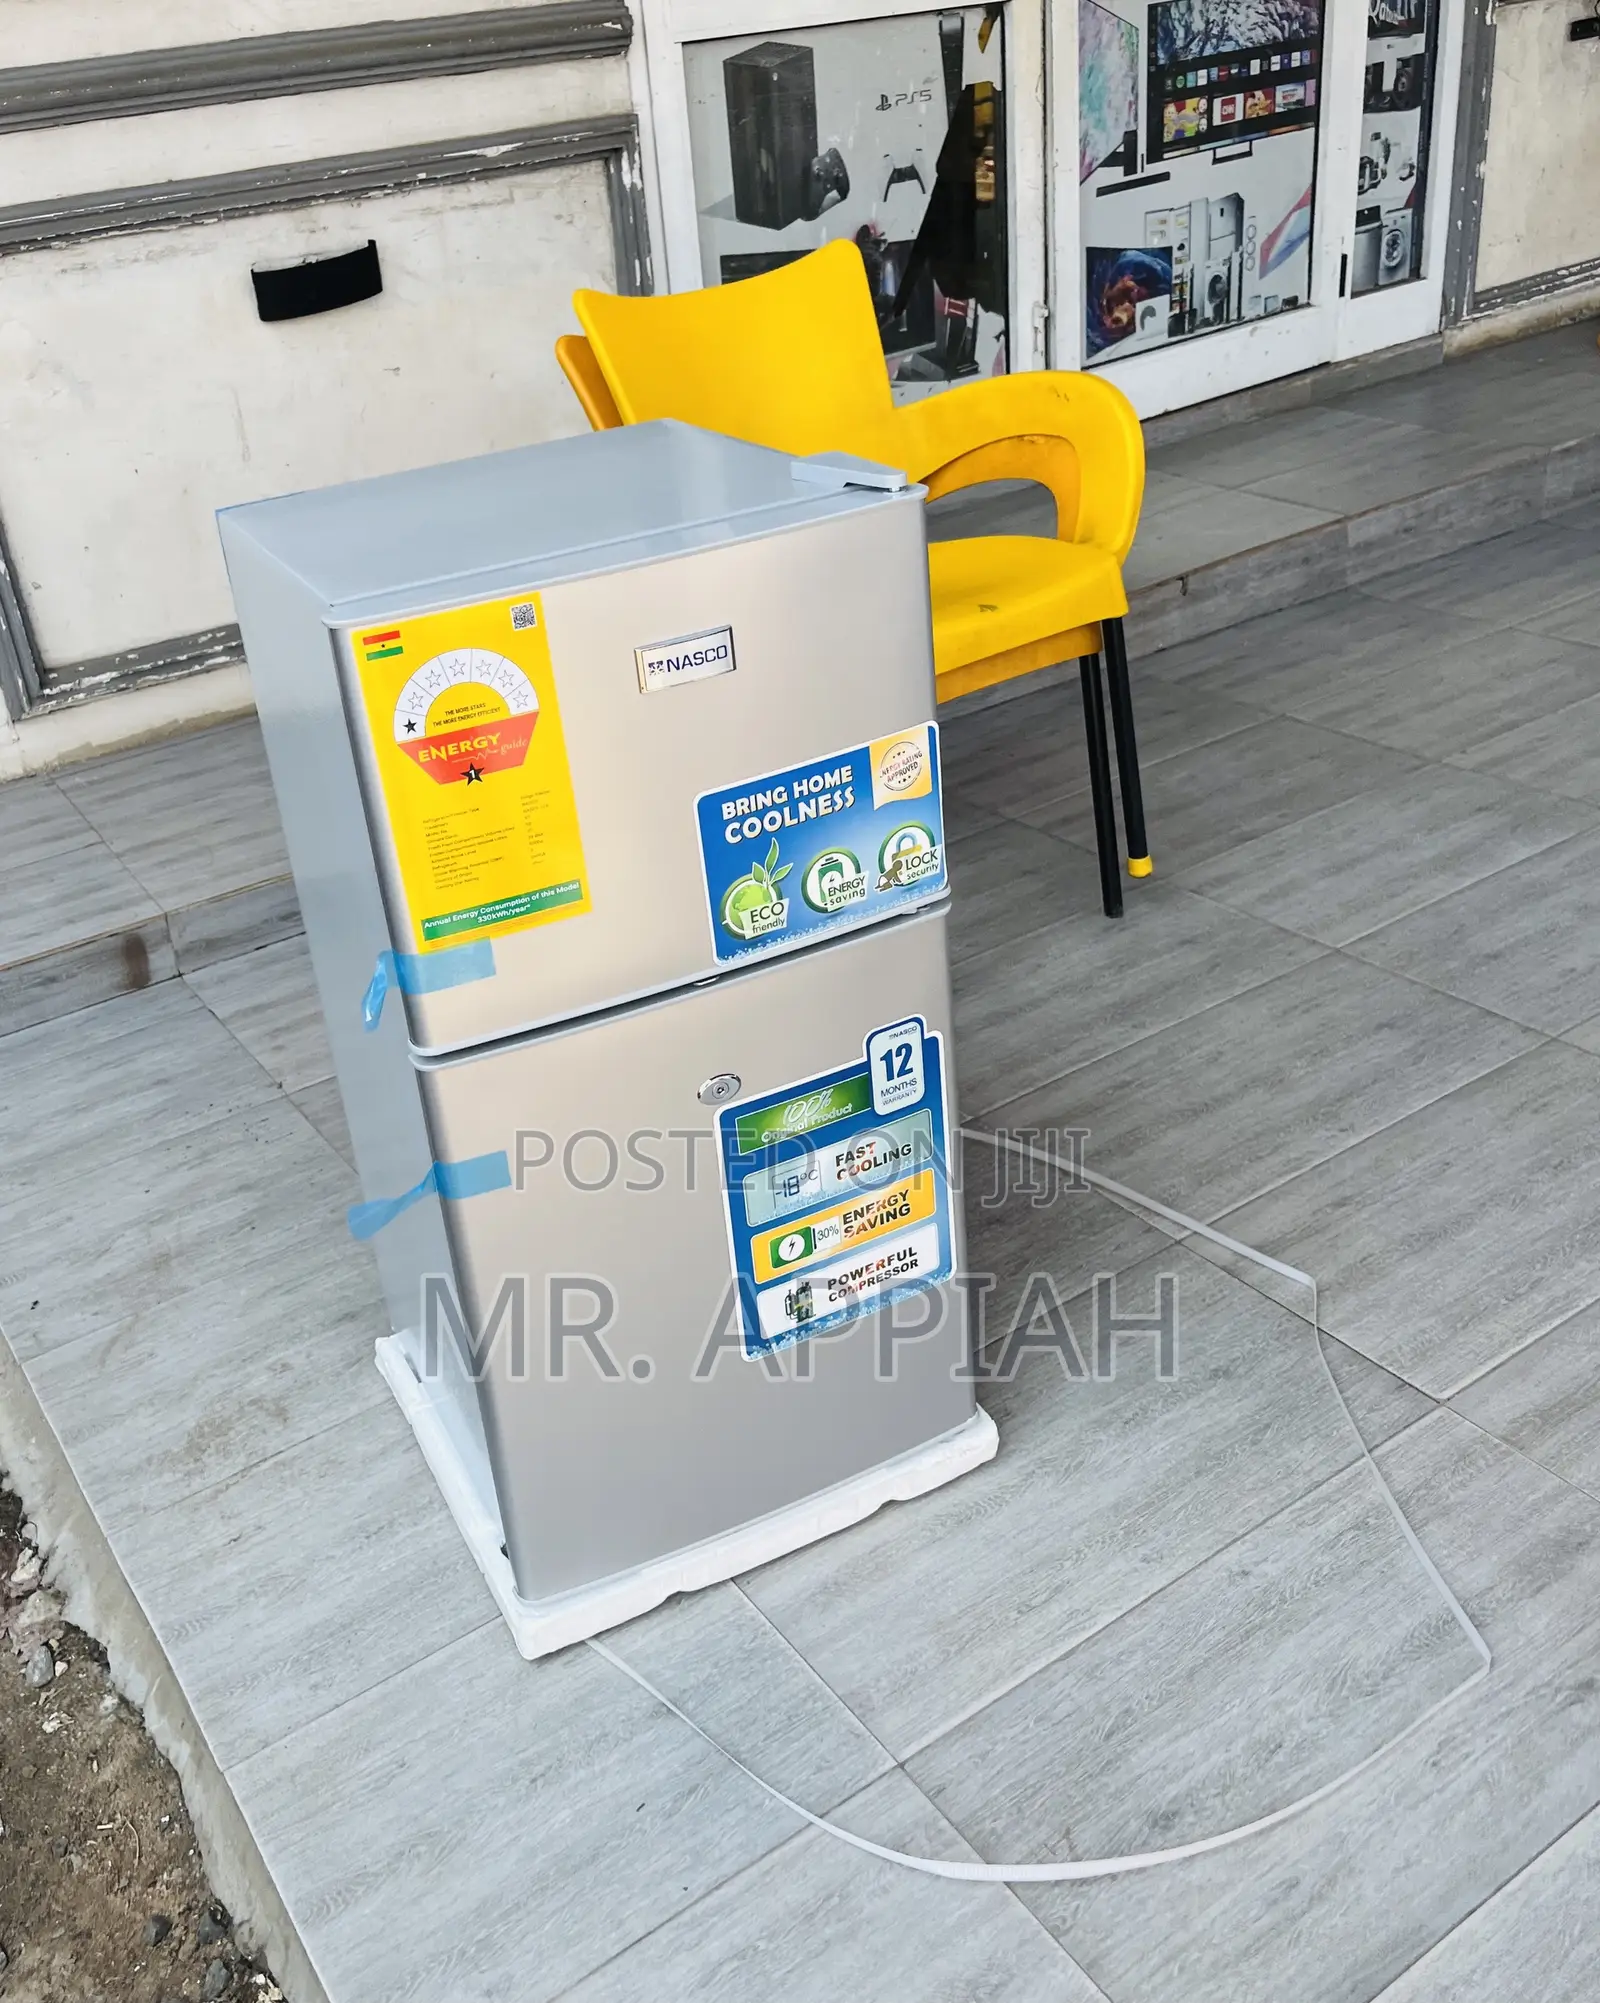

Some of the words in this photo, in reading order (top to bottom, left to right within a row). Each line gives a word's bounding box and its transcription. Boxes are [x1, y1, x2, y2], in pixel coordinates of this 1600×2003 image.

[895, 89, 932, 106] PS5
[666, 644, 728, 673] NASCO
[445, 708, 455, 717] THE
[455, 706, 469, 715] MORE
[470, 702, 487, 712] STARS
[432, 720, 442, 729] THE
[443, 717, 457, 725] MORE
[457, 713, 477, 723] ENERGY
[418, 732, 501, 764] ENERGY
[500, 737, 529, 756] guide
[469, 769, 476, 779] 1
[887, 761, 919, 783] APPROVED
[721, 786, 789, 821] BRING
[792, 765, 854, 799] HOME
[724, 785, 856, 844] COOLNESS
[905, 848, 939, 871] LOCK
[906, 863, 940, 881] security
[828, 875, 866, 897] ENERGY
[424, 916, 452, 929] Annual
[452, 910, 479, 923] Energy
[479, 897, 531, 914] Consumption
[531, 892, 540, 901] of
[540, 889, 555, 899] this
[556, 881, 580, 895] Model
[829, 888, 866, 907] saving
[750, 903, 785, 924] ECO
[752, 918, 786, 935] friendly
[893, 1025, 918, 1039] NASCO
[880, 1042, 914, 1083] 12
[880, 1077, 918, 1098] MONTHS
[882, 1088, 917, 1106] WARRANTY
[783, 1088, 834, 1126] 100%
[761, 1117, 808, 1143] Original
[811, 1102, 853, 1126] Product
[835, 1141, 877, 1167] FAST
[836, 1143, 912, 1181] COOLING
[842, 1189, 909, 1226] ENERGY
[817, 1223, 840, 1241] 30%
[843, 1203, 911, 1239] SAVING
[828, 1246, 918, 1291] POWERFUL
[828, 1258, 919, 1302] COMPRESSOR
